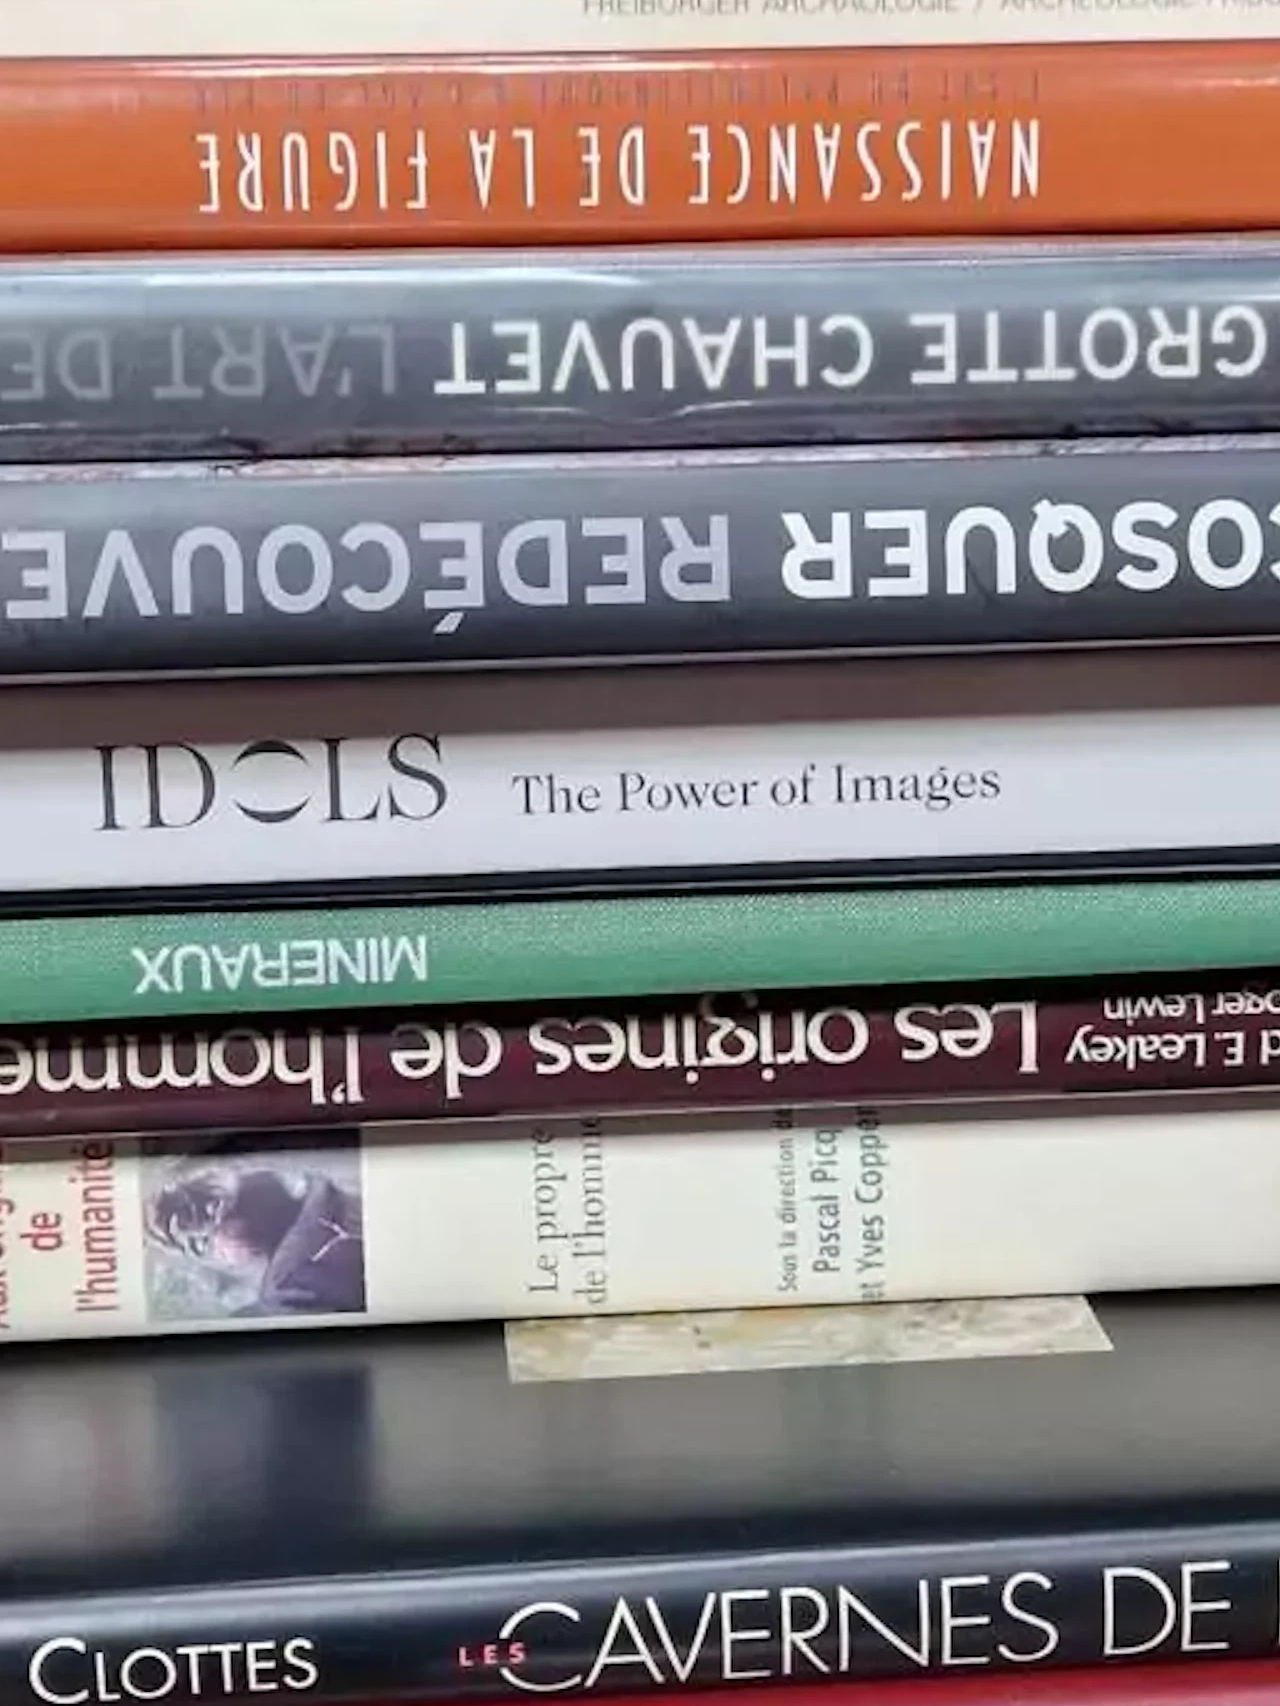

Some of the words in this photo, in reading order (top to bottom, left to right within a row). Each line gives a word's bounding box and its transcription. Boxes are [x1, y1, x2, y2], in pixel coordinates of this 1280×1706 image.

[193, 130, 429, 213] FIGURE
[465, 129, 538, 208] LA
[577, 126, 647, 207] DE
[683, 120, 1040, 205] NAISSANCE
[153, 321, 396, 399] L'ART
[435, 309, 875, 397] CHAUVET
[910, 305, 1266, 386] GROTTE
[94, 733, 448, 833] IDOLS
[510, 775, 600, 814] The
[618, 773, 756, 814] Power
[770, 767, 816, 805] of
[832, 765, 1001, 810] Images
[131, 935, 428, 994] MINERAUX
[529, 993, 868, 1080] origines
[894, 1001, 1039, 1072] Les
[1066, 1027, 1207, 1067] Leakey
[1105, 993, 1205, 1023] Lewin
[390, 1020, 503, 1100] de
[1211, 1030, 1245, 1065] E.
[531, 1129, 567, 1243] propre
[774, 1138, 795, 1223] direction
[809, 1129, 842, 1182] Picq
[20, 1212, 63, 1251] de
[70, 1141, 121, 1312] l'humanité
[806, 1195, 840, 1272] Pascal
[855, 1215, 884, 1272] Yves
[528, 1255, 559, 1292] Le
[574, 1271, 606, 1305] de
[777, 1255, 797, 1292] Sous
[458, 1643, 527, 1669] LES
[498, 1573, 1058, 1694] CAVERNES
[1101, 1559, 1234, 1651] DE
